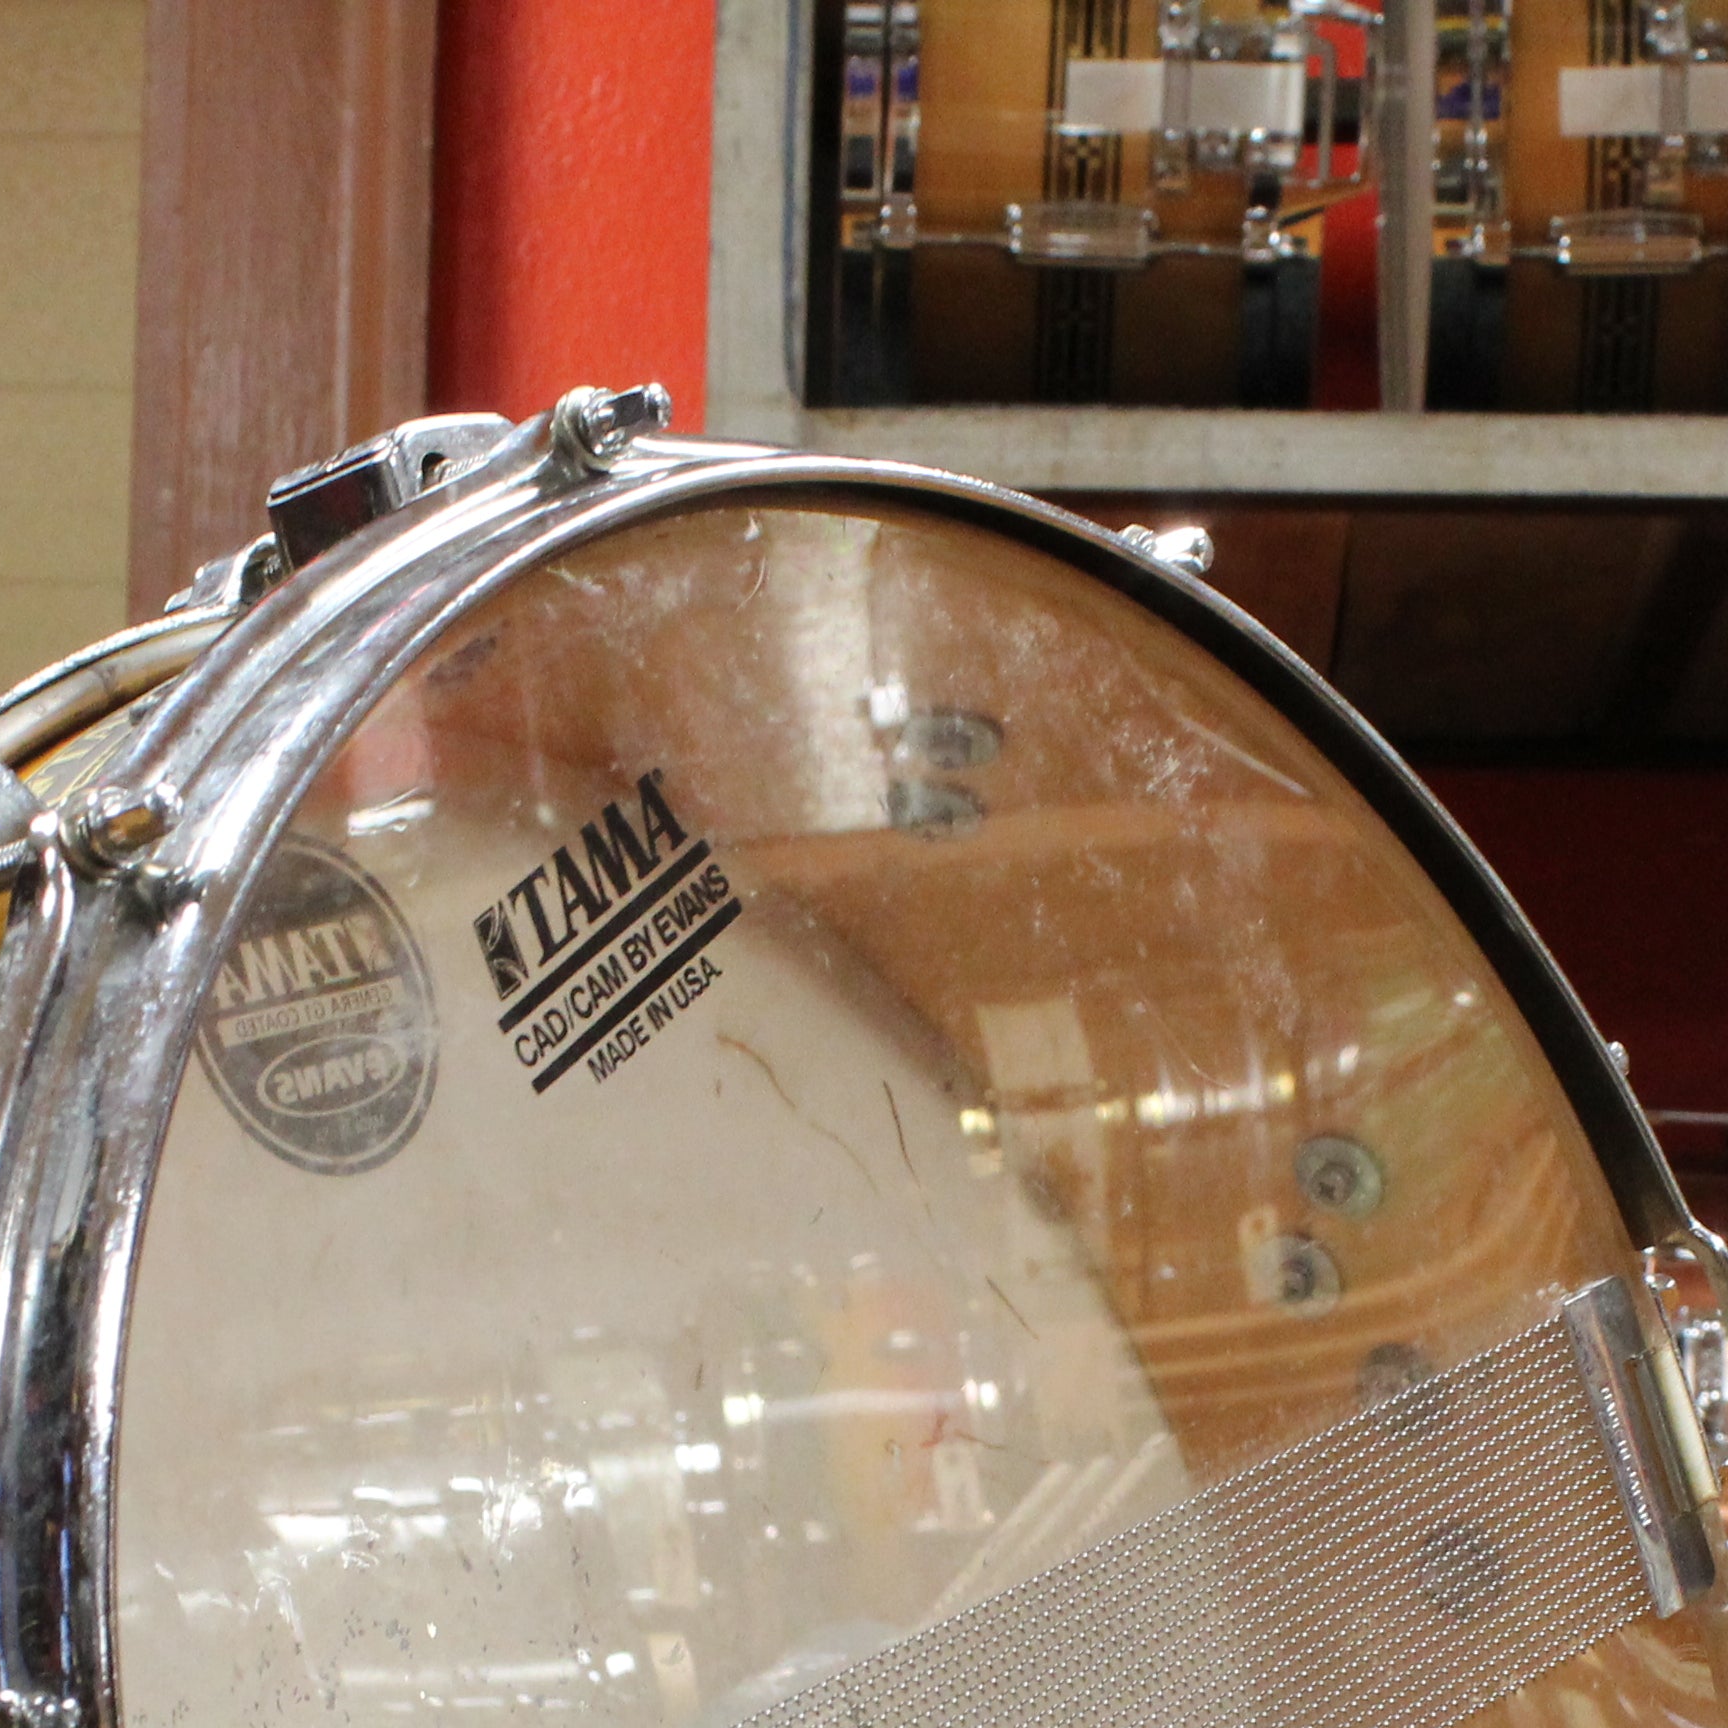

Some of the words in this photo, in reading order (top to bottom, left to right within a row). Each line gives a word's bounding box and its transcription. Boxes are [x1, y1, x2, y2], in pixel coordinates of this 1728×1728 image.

[508, 774, 688, 967] TAMA
[514, 954, 627, 1067] CAD/CAM
[621, 925, 657, 972] BY
[653, 863, 729, 946] EVANS
[587, 1014, 650, 1083] MADE
[646, 995, 673, 1031] IN
